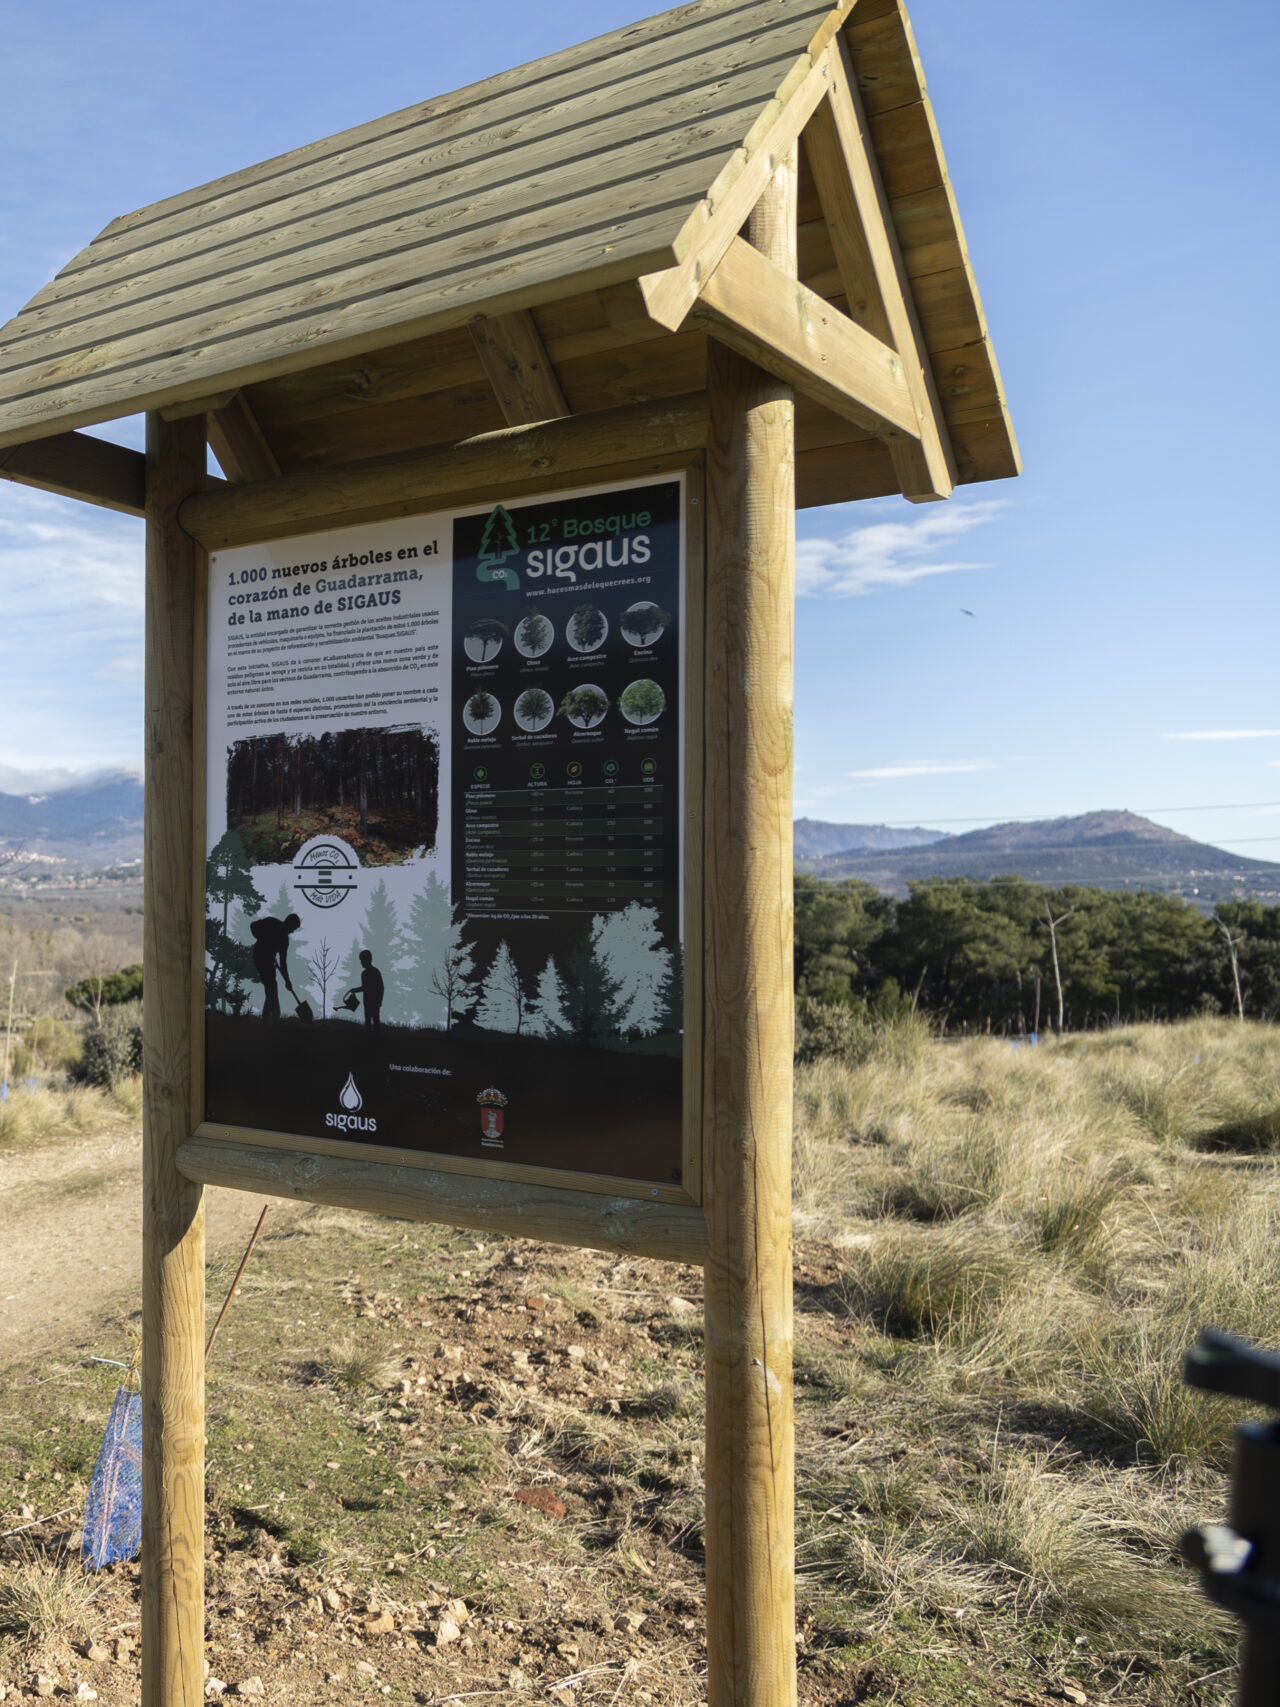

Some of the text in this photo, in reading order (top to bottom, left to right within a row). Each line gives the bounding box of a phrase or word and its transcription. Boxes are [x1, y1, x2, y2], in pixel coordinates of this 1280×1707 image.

[563, 511, 652, 538] Bosque
[229, 540, 438, 586] 1.000 nuevos árboles en el
[525, 534, 652, 583] sigaus
[228, 569, 423, 606] corazón de Guadarrama,
[526, 576, 651, 597] www.hacesmasdeloquecrees.org
[228, 589, 401, 626] de la mano de SIGAUS
[402, 1065, 441, 1074] colaboración
[325, 1112, 377, 1132] sigaus
